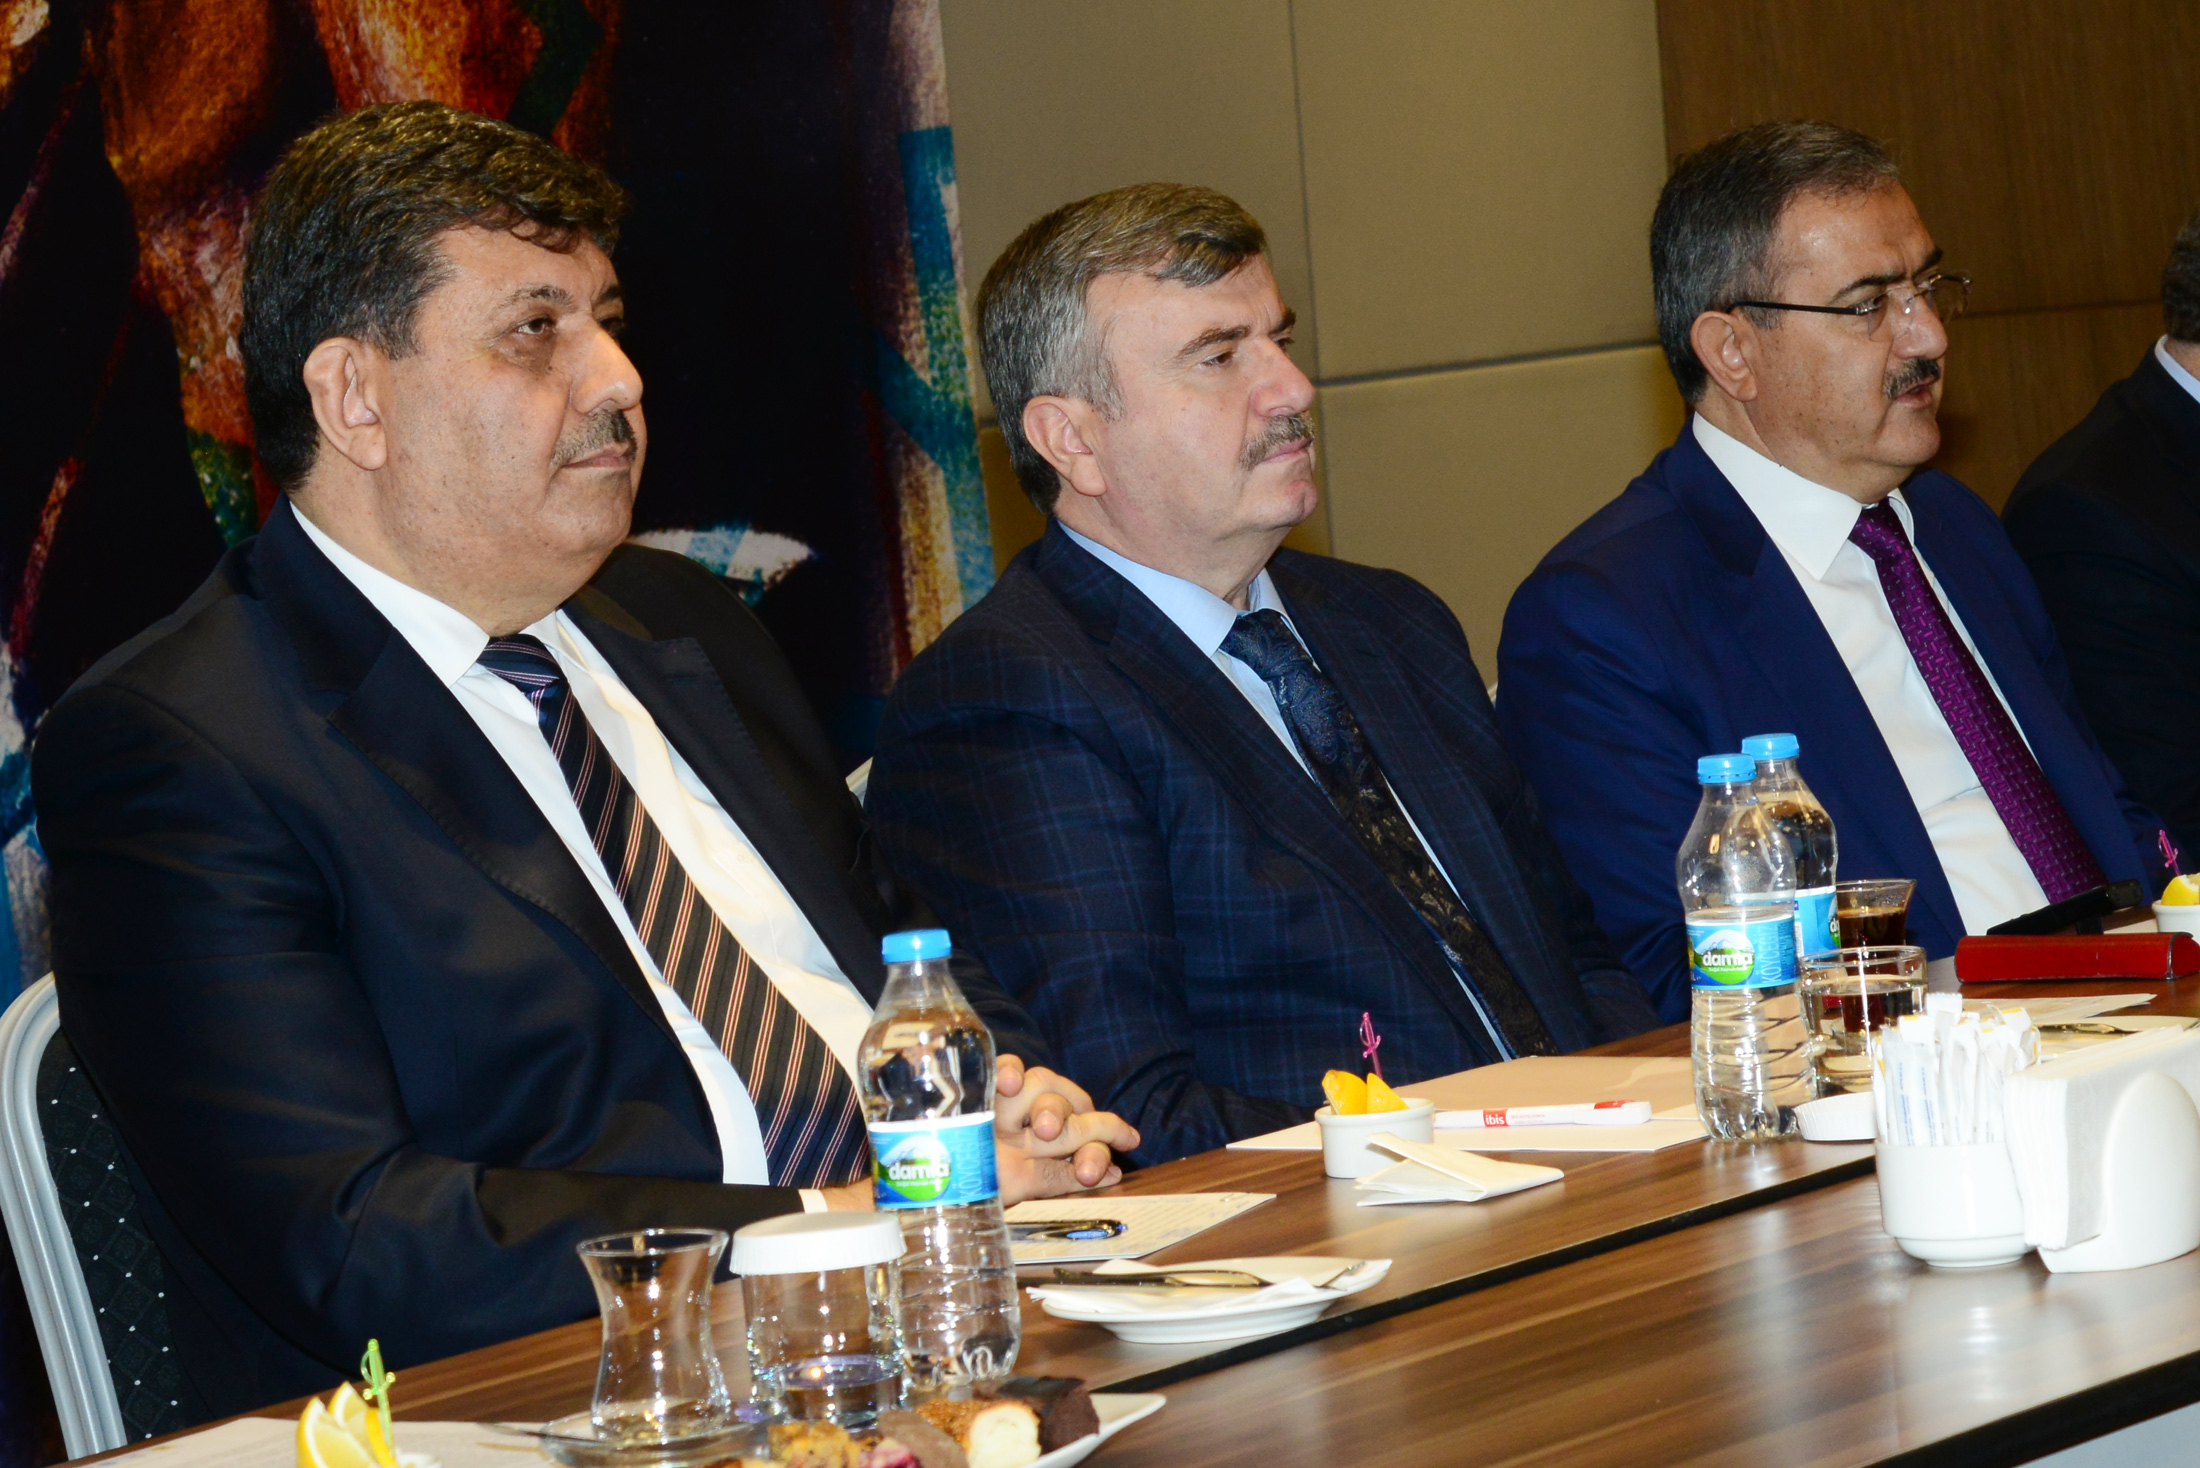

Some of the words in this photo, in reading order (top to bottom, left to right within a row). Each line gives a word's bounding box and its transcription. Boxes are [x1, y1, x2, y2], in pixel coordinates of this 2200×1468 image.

[1702, 950, 1753, 967] damla
[1485, 1114, 1505, 1126] ibis
[888, 1161, 950, 1180] damla
